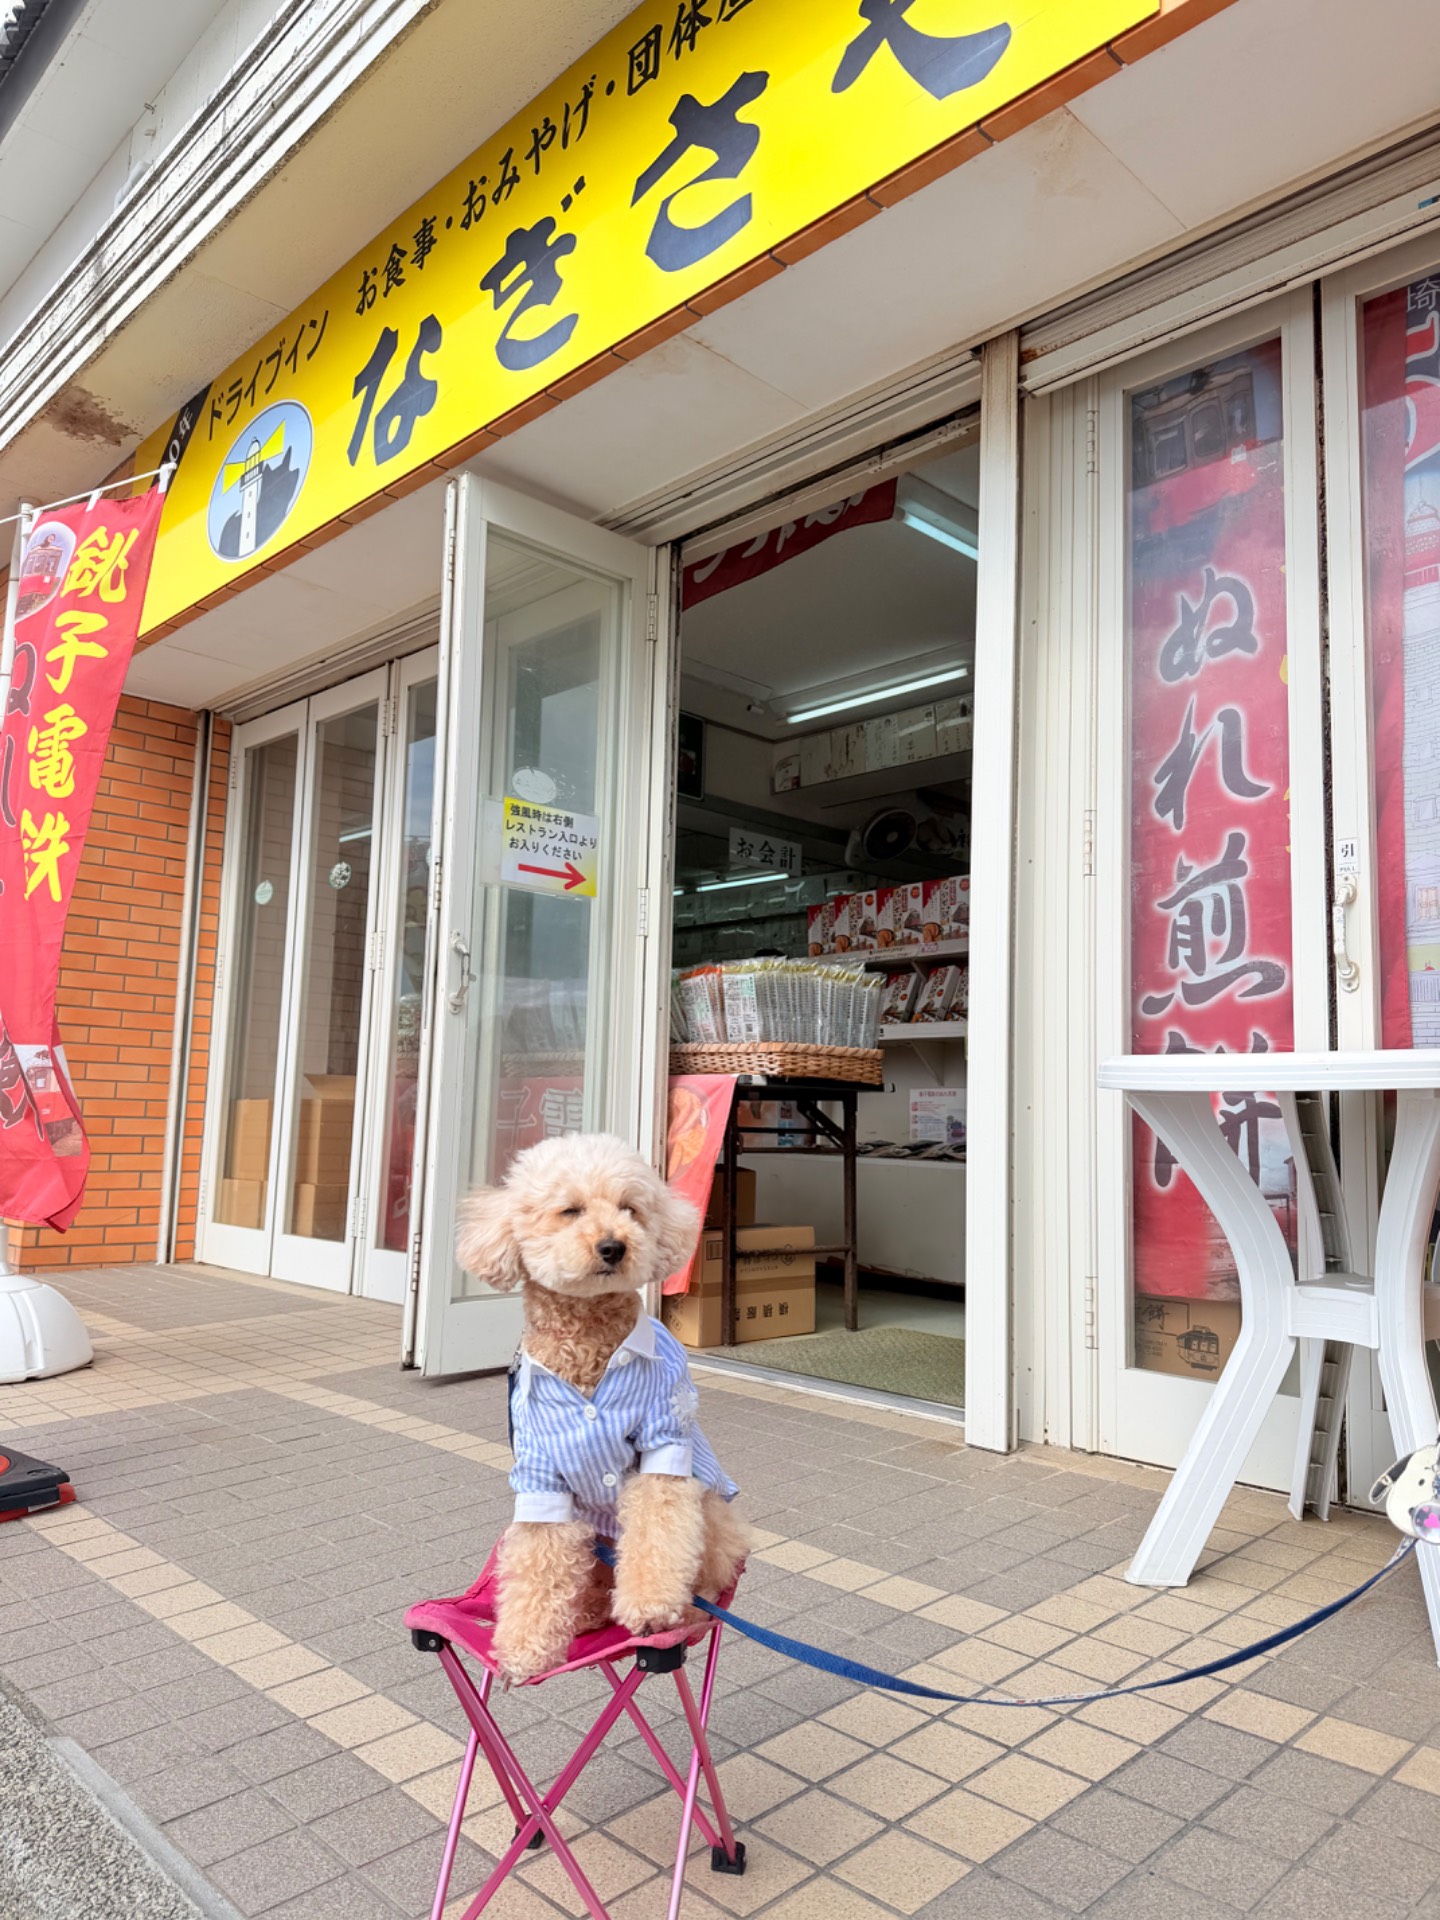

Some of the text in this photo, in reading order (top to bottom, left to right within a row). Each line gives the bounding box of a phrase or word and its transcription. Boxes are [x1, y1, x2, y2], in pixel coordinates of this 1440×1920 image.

[207, 309, 329, 441] ドライブイン
[509, 803, 574, 829] 強風時は右側
[506, 819, 598, 850] レストラン入口より
[508, 836, 583, 861] お入りください
[737, 836, 797, 870] お会計
[1341, 843, 1354, 857] 引
